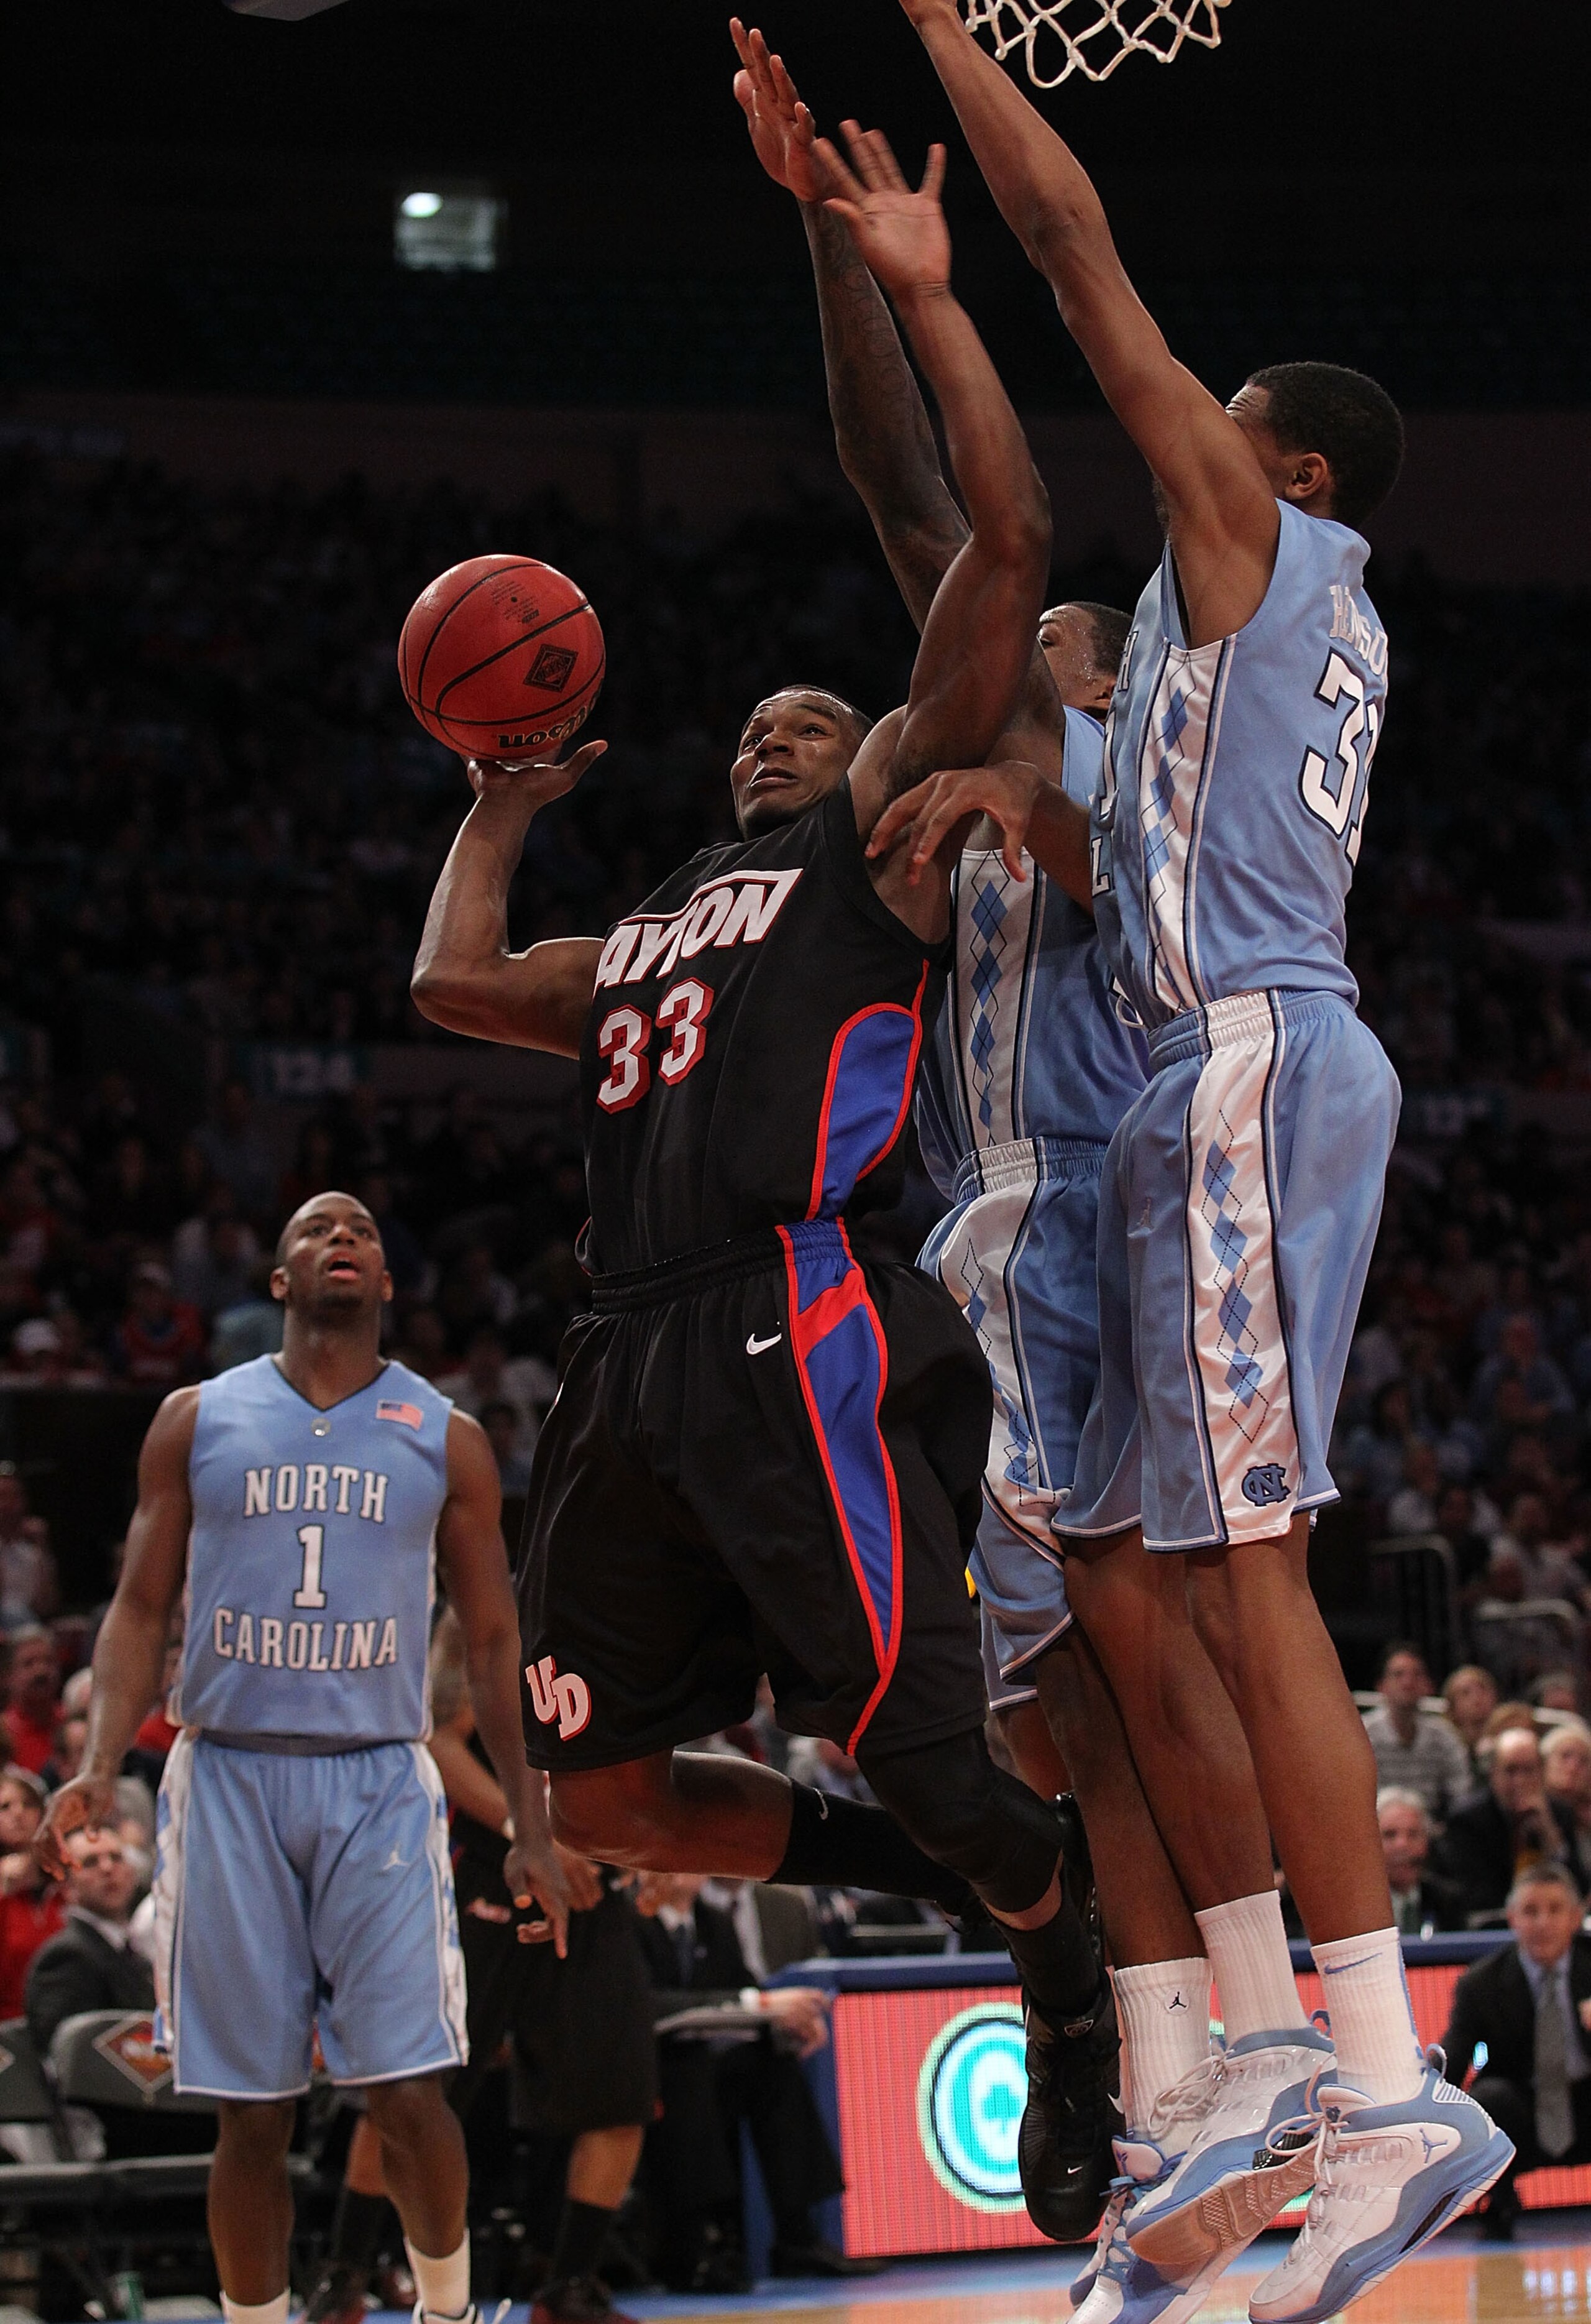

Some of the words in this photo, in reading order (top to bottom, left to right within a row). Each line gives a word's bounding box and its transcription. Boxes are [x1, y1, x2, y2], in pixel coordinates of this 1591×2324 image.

[1329, 584, 1389, 676] HENSO
[1298, 646, 1377, 868] 31
[592, 868, 804, 1004] AYTON
[595, 976, 715, 1116] 33
[243, 1463, 388, 1524] NORTH
[293, 1523, 328, 1610] 1
[213, 1607, 398, 1673] CAROLINA
[525, 1653, 593, 1742] UD
